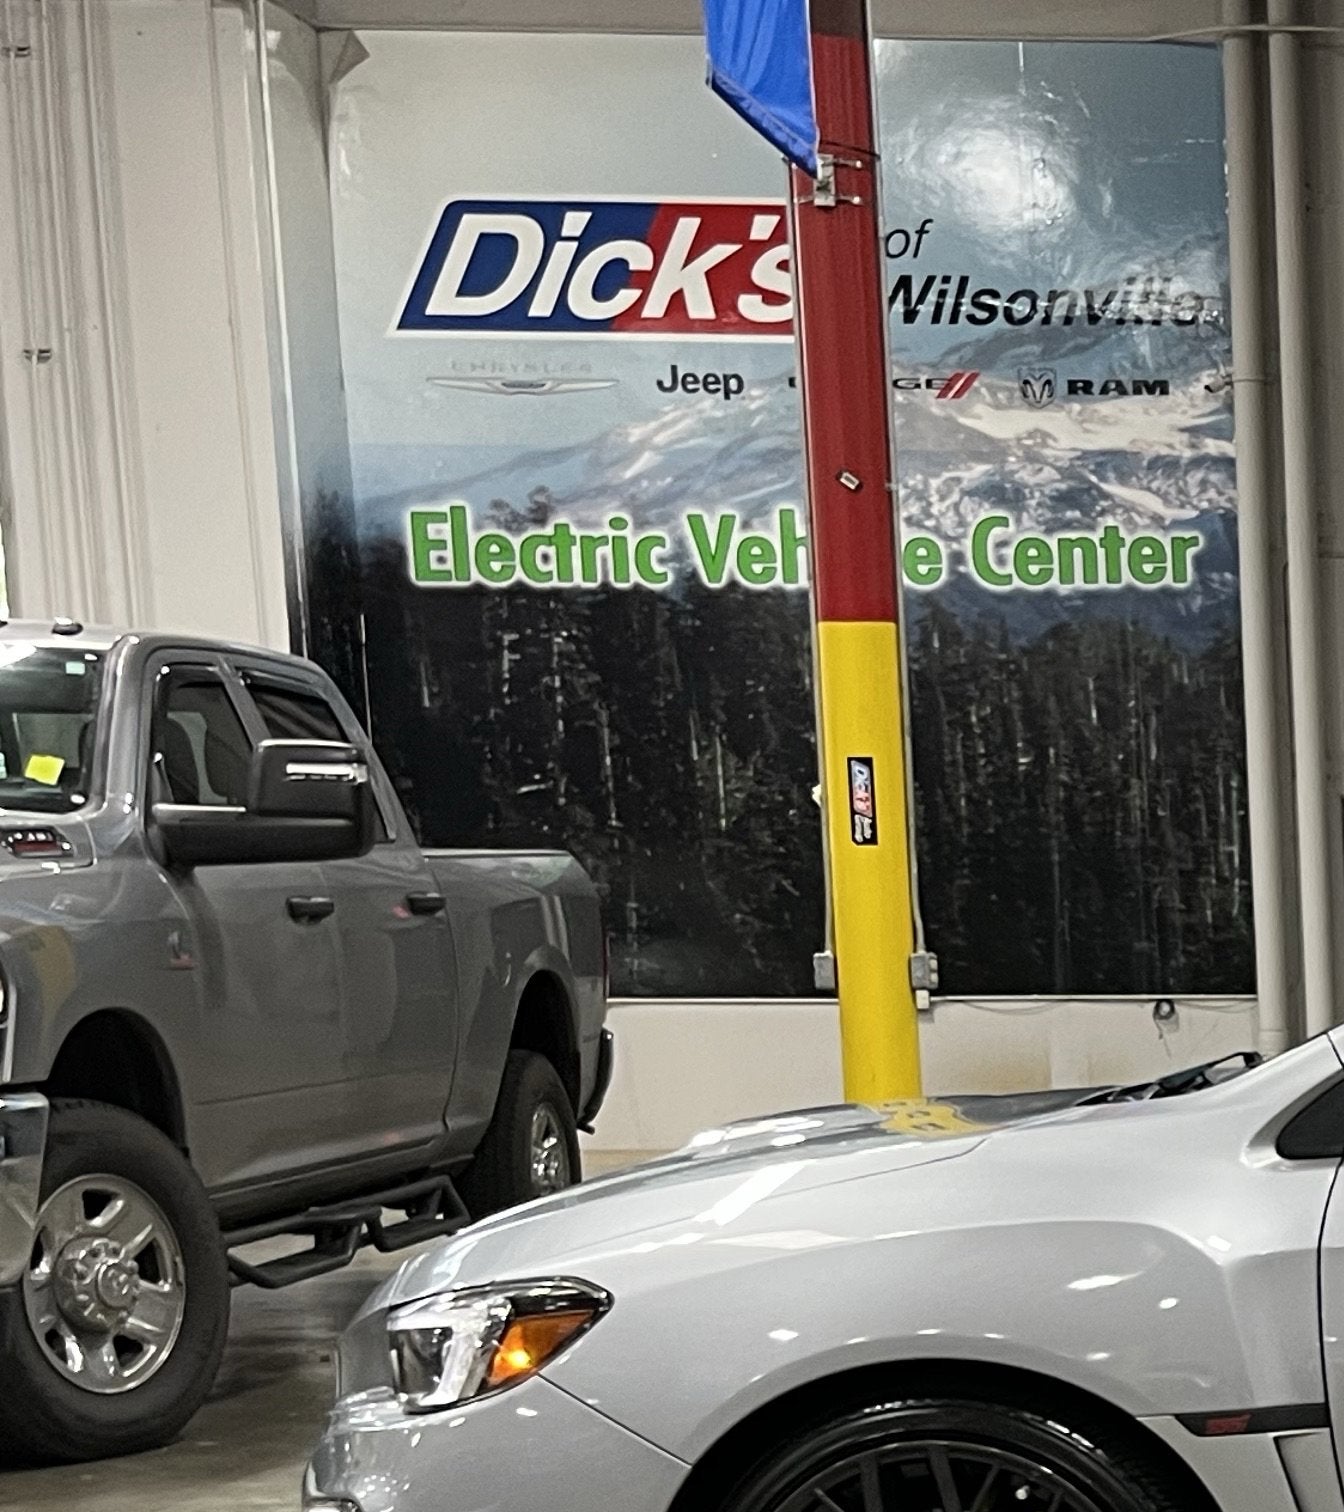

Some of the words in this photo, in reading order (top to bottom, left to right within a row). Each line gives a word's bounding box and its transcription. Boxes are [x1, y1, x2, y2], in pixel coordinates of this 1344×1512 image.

[885, 218, 934, 259] of
[424, 210, 794, 323] Dick's
[655, 364, 745, 400] Jeep
[1066, 378, 1170, 396] RAM
[410, 505, 668, 584] Electric
[687, 508, 943, 586] Vehe
[971, 514, 1200, 586] Center
